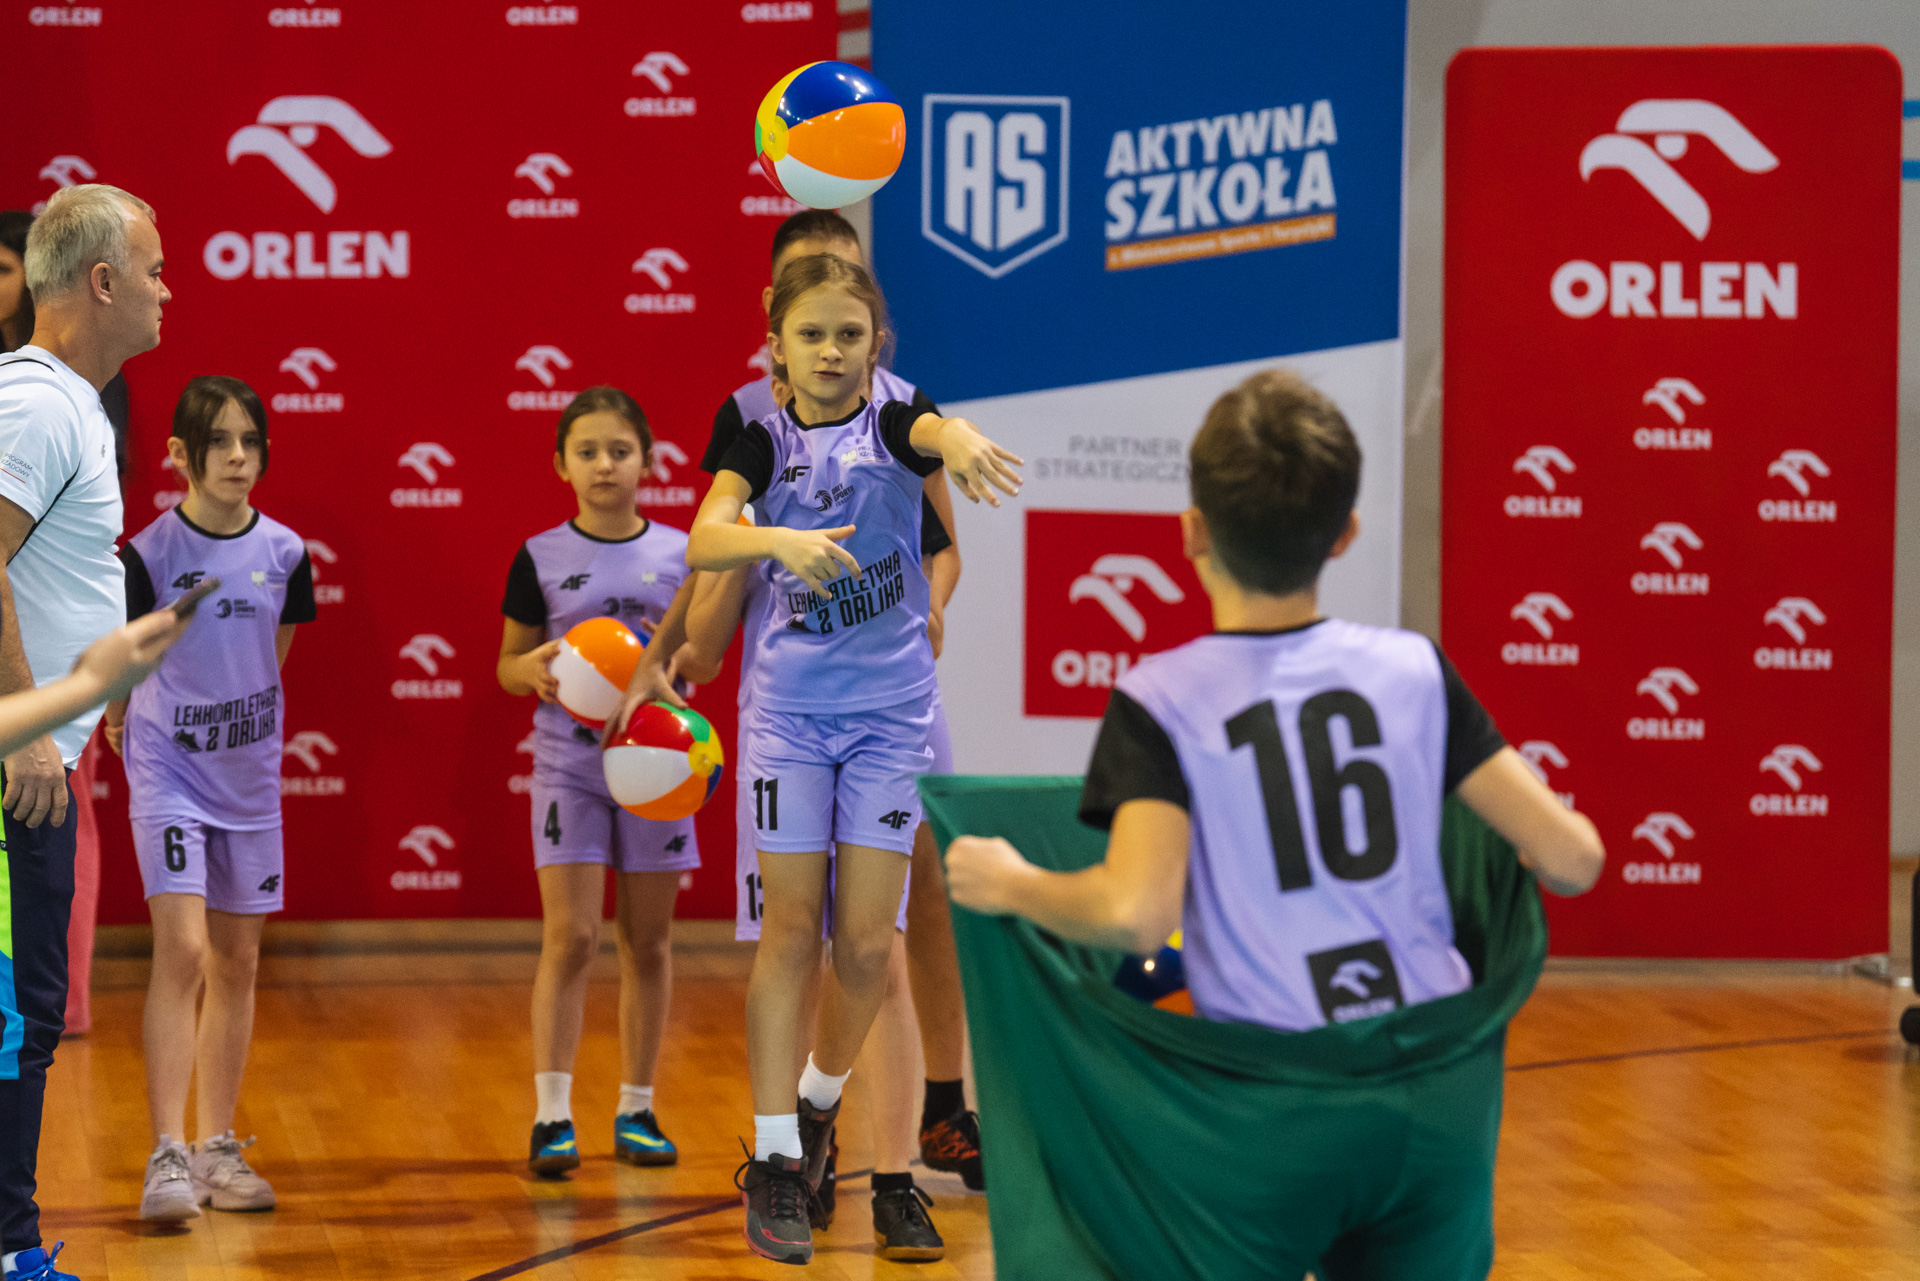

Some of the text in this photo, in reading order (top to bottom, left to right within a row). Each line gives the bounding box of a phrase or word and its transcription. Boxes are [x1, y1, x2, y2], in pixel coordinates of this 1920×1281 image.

[29, 7, 102, 26] ORLEN
[269, 8, 341, 27] ORLEN
[506, 6, 578, 25] ORLEN
[742, 3, 812, 22] ORLEN
[1105, 99, 1338, 179] AKTYWNA
[944, 111, 1046, 252] AS
[1105, 149, 1337, 241] SZKOŁA
[507, 199, 578, 218] ORLEN
[203, 231, 410, 280] ORLEN
[1550, 259, 1799, 320] ORLEN
[271, 393, 344, 412] ORLEN
[1068, 435, 1182, 458] PARTNER
[1633, 428, 1713, 450] ORLEN
[390, 489, 462, 507] ORLEN
[1504, 496, 1582, 518] ORLEN
[1758, 500, 1837, 522] ORLEN
[1631, 573, 1709, 595] ORLEN
[1501, 643, 1580, 665] ORLEN
[1753, 648, 1833, 670] ORLEN
[391, 680, 462, 699] ORLEN
[1627, 718, 1705, 740] ORLEN
[1225, 688, 1398, 894] 16
[753, 777, 778, 831] 11
[1750, 794, 1828, 816] ORLEN
[544, 801, 563, 846] 4
[878, 809, 912, 830] 4F
[163, 826, 187, 872] 6
[258, 874, 280, 893] 4F
[390, 871, 461, 890] ORLEN
[1623, 863, 1701, 884] ORLEN
